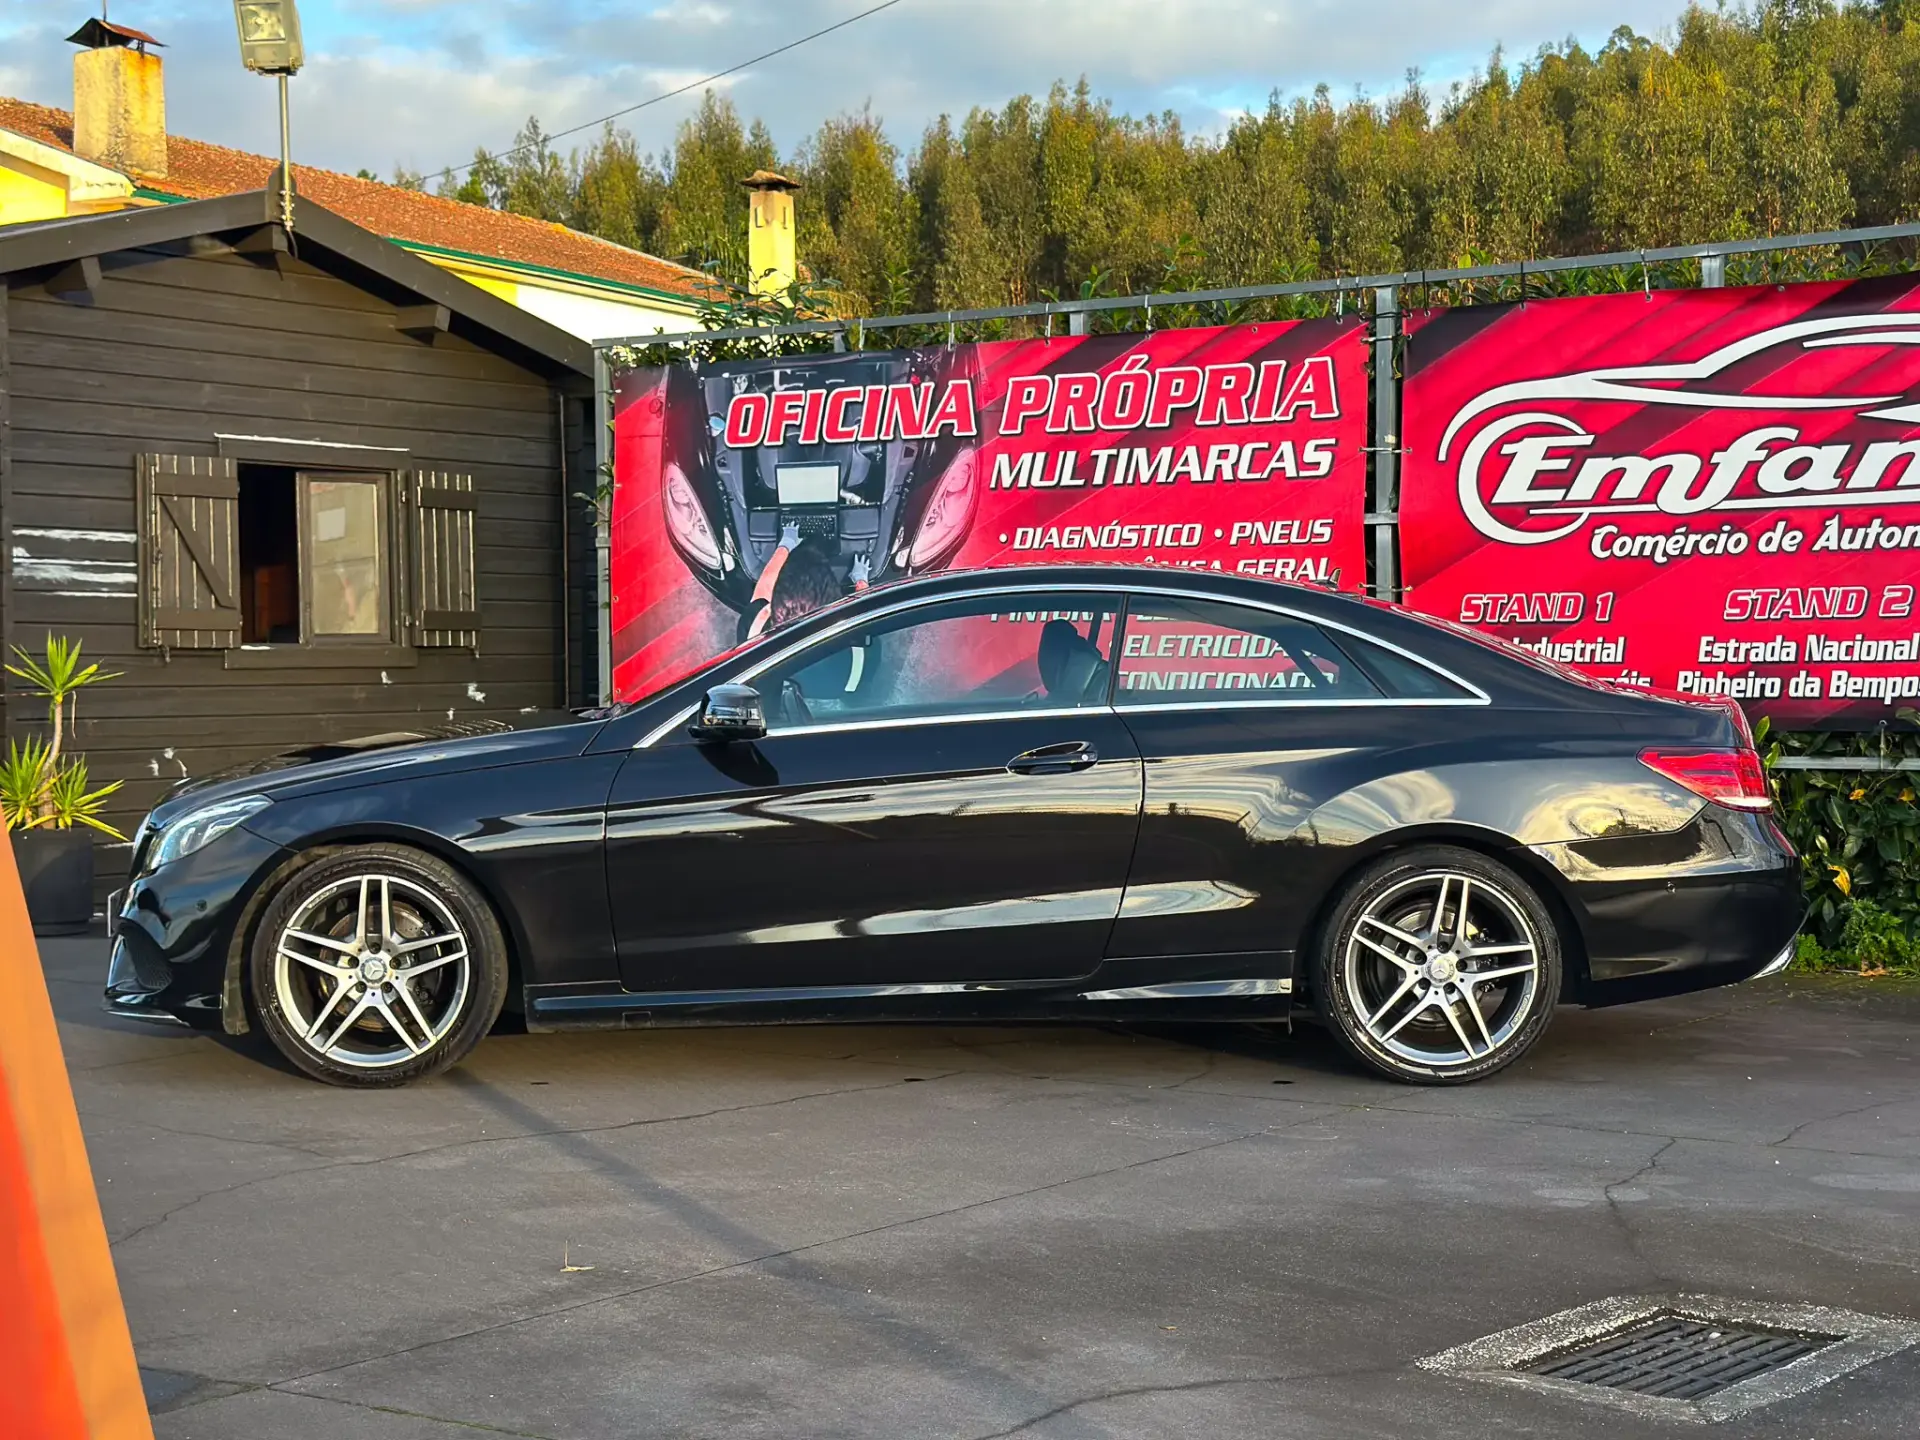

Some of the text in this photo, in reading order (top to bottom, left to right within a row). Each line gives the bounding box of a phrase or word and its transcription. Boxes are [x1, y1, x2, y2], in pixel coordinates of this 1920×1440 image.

[724, 354, 1340, 447] OFICINA PRÓPRIA
[989, 438, 1336, 488] MULTIMARCAS
[1013, 519, 1333, 549] DIAGNÓSTICO PNEUS
[1591, 525, 1748, 563] Comércio
[1758, 521, 1803, 553] de
[1460, 591, 1613, 622] STAND 1
[1723, 585, 1914, 620] STAND 2
[1512, 637, 1624, 663] dustrial
[1698, 633, 1920, 662] Estrada Nacional
[1677, 671, 1781, 698] Pinheiro
[1789, 671, 1821, 698] da
[1829, 670, 1920, 705] Bempo
